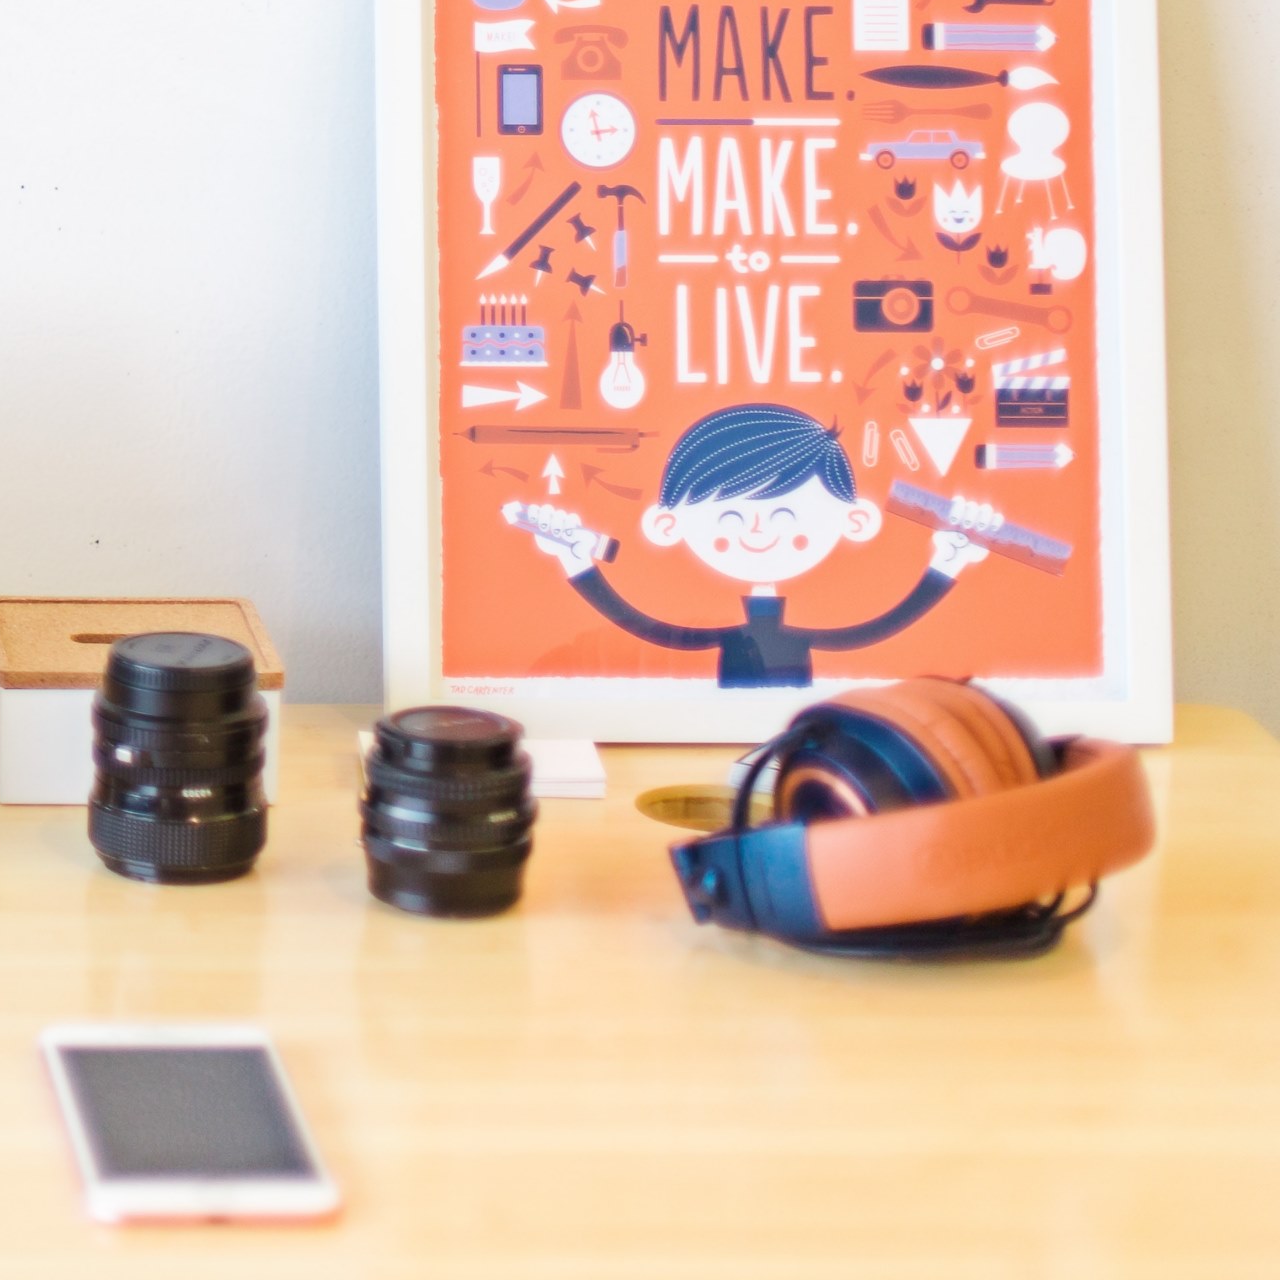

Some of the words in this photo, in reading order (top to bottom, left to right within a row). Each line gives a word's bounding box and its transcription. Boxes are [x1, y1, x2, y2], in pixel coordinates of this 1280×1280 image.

[658, 3, 855, 103] MAKE.
[657, 135, 860, 238] MAKE.
[724, 247, 772, 274] to
[676, 284, 845, 386] LIVE.
